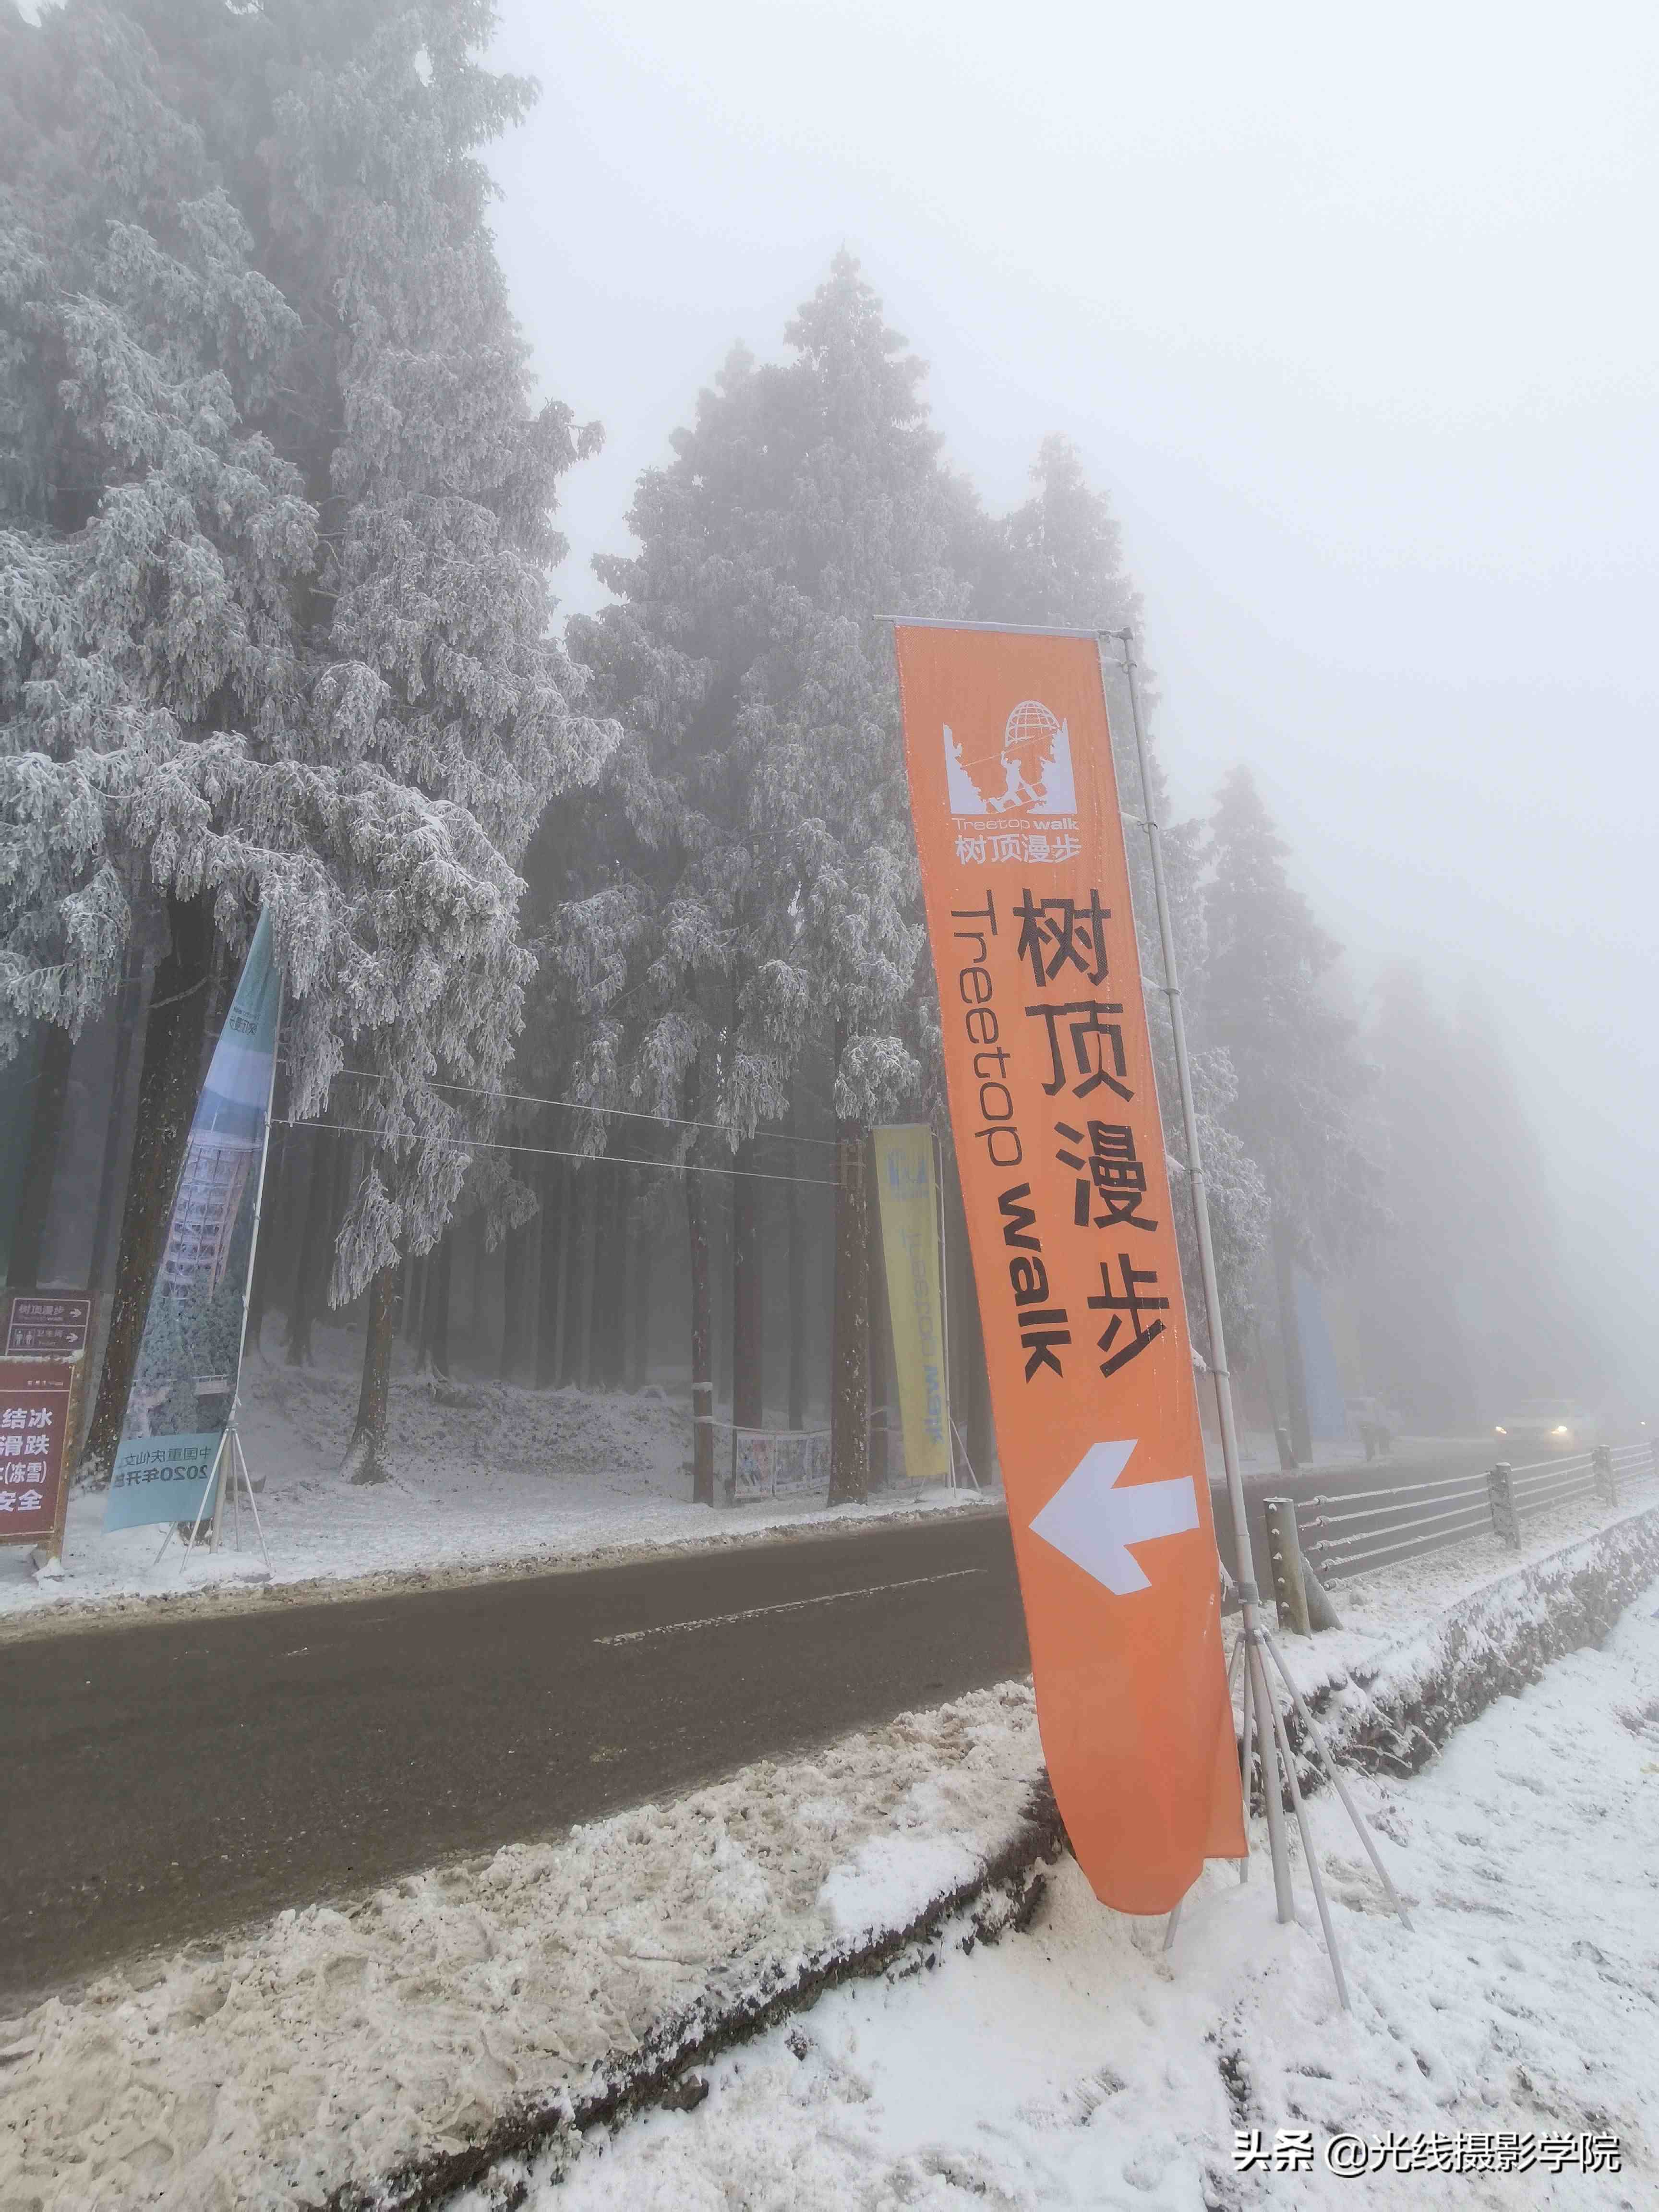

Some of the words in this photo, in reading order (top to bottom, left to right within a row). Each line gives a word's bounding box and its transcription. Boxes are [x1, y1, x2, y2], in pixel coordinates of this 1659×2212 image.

[951, 817, 1030, 830] Treetop
[1033, 817, 1080, 830] walk
[955, 833, 1082, 865] 树顶漫步
[950, 889, 1022, 1166] Treetop
[997, 1182, 1072, 1384] walk
[1012, 888, 1170, 1378] 树顶漫步
[0, 1489, 43, 1512] 安全
